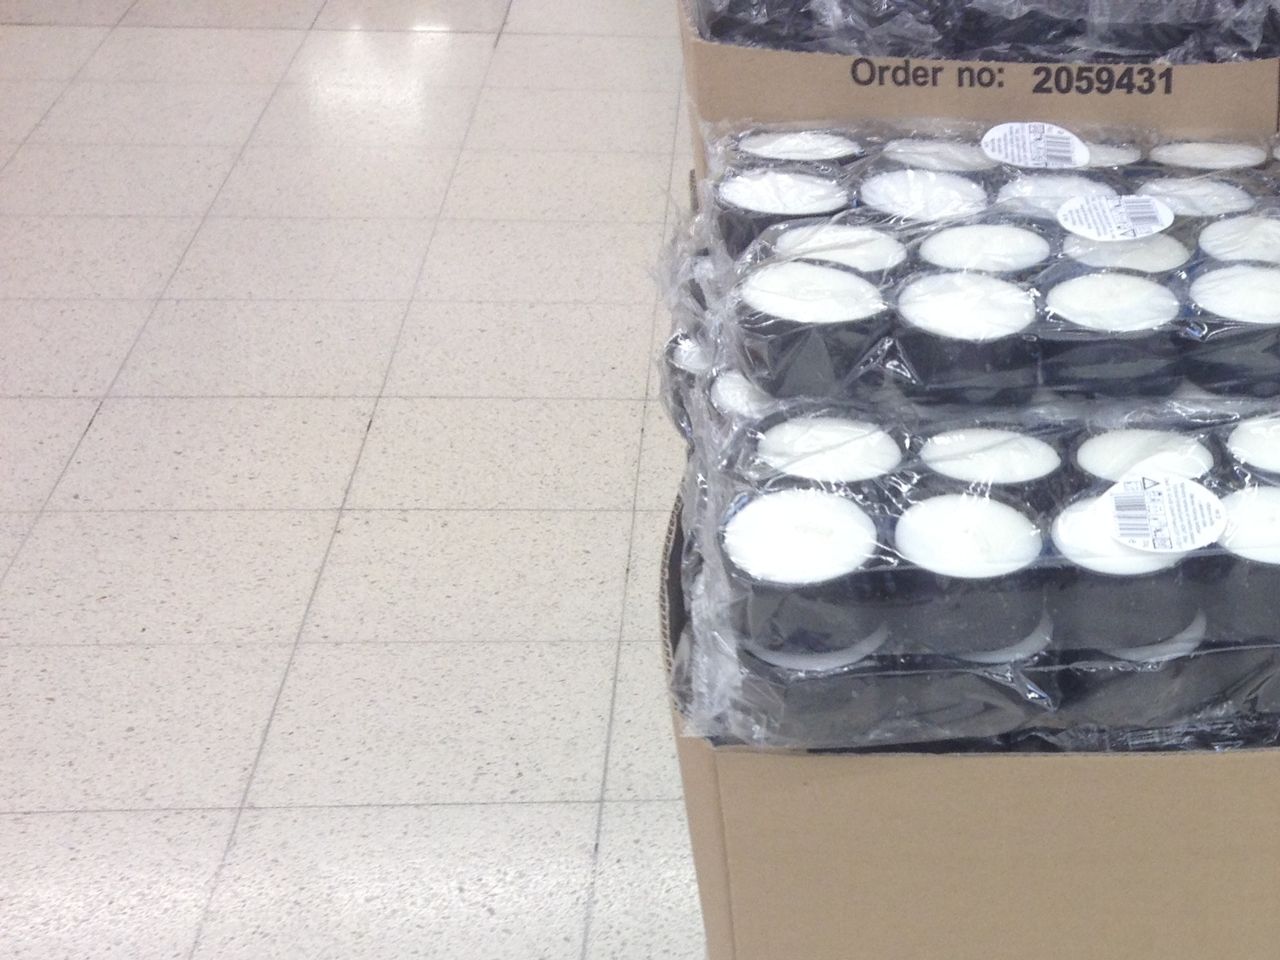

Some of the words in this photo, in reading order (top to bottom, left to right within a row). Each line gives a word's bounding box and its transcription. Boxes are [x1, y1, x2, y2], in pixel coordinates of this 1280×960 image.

[851, 57, 944, 87] Order
[957, 63, 1004, 88] no:
[1032, 66, 1175, 95] 2059431
